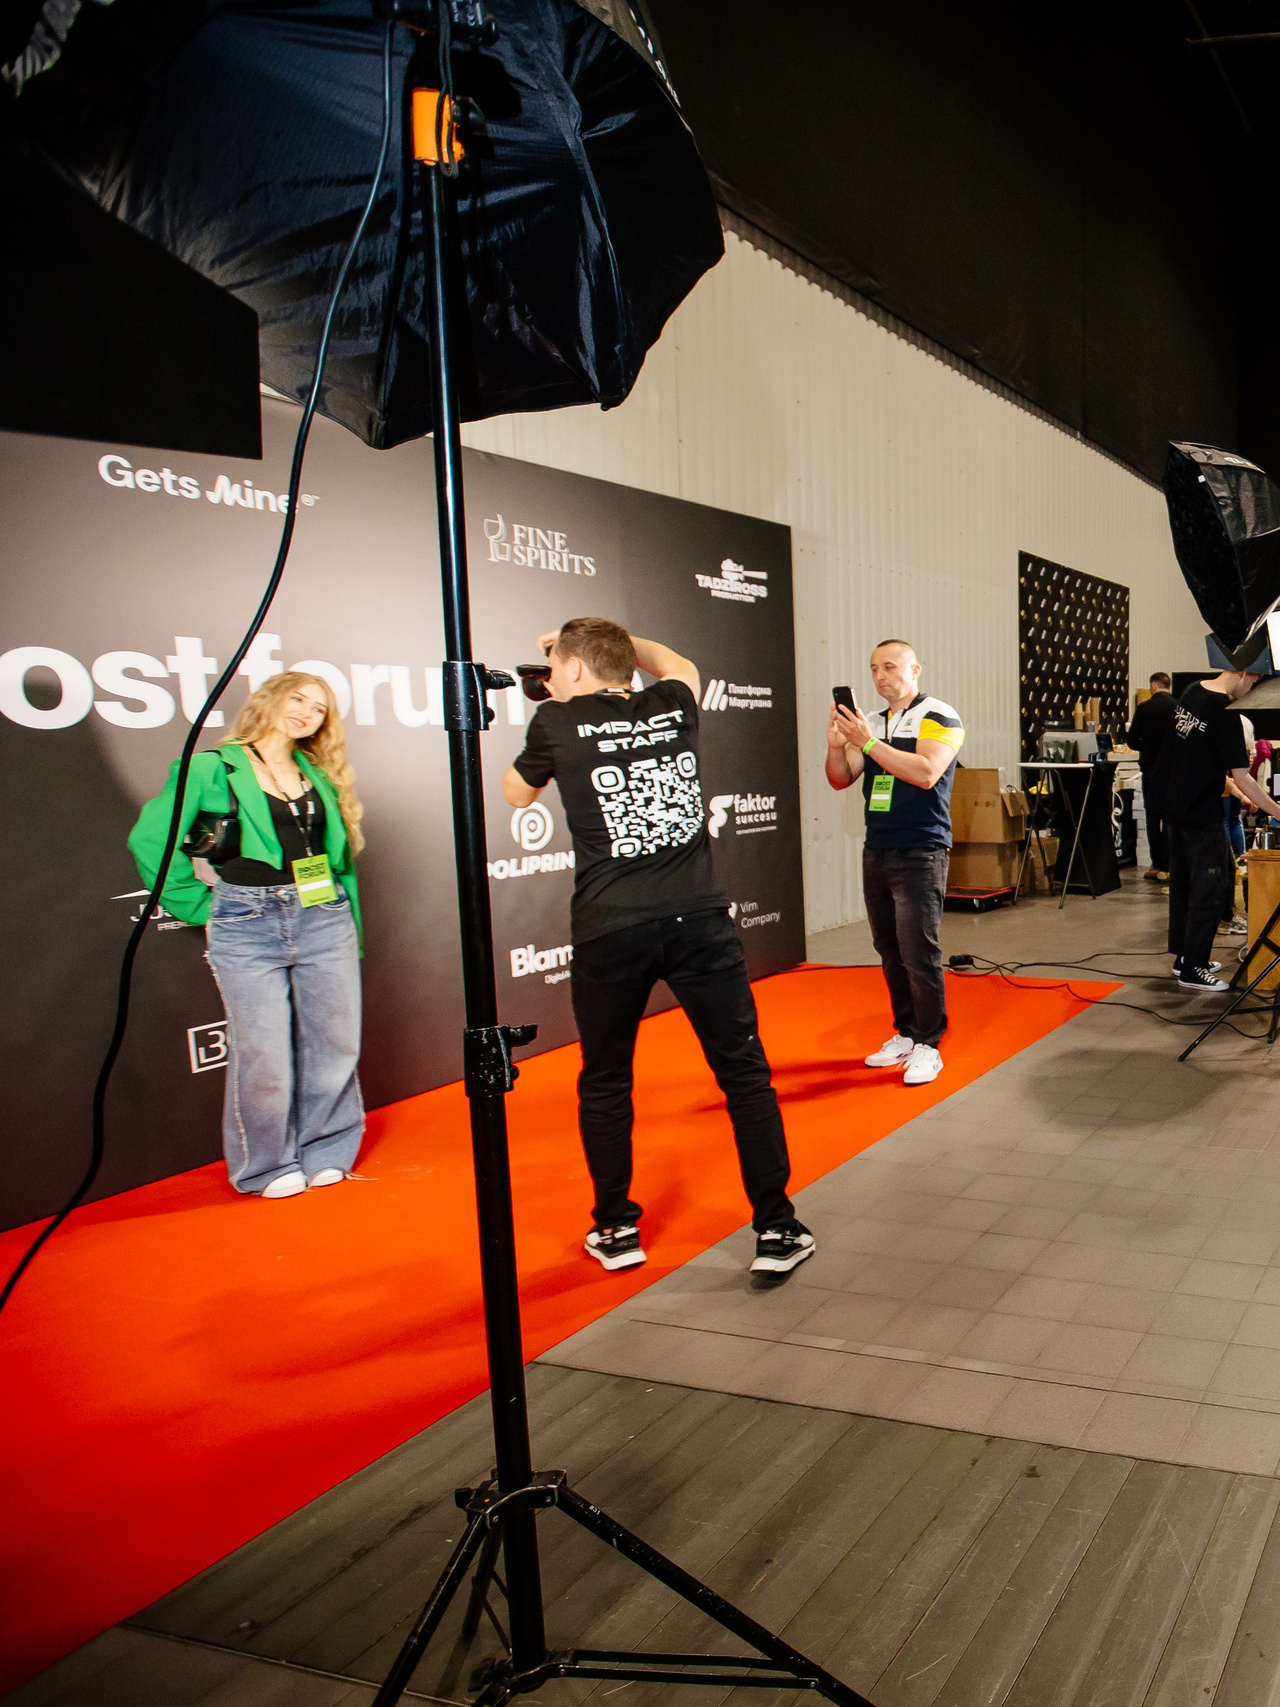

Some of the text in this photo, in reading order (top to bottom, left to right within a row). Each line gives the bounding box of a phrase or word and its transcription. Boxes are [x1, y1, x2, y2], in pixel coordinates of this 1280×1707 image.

[97, 454, 201, 500] Gets
[511, 523, 569, 553] FINE
[513, 545, 598, 578] SPIRITS
[727, 683, 773, 697] Платформа
[728, 696, 773, 710] Маргулана
[576, 710, 684, 738] IMPACT
[597, 729, 679, 753] STAFF
[733, 793, 777, 814] faktor
[735, 811, 779, 826] sukcesu
[487, 850, 576, 880] OLIPRIN
[740, 901, 758, 914] Vim
[741, 910, 782, 929] Company
